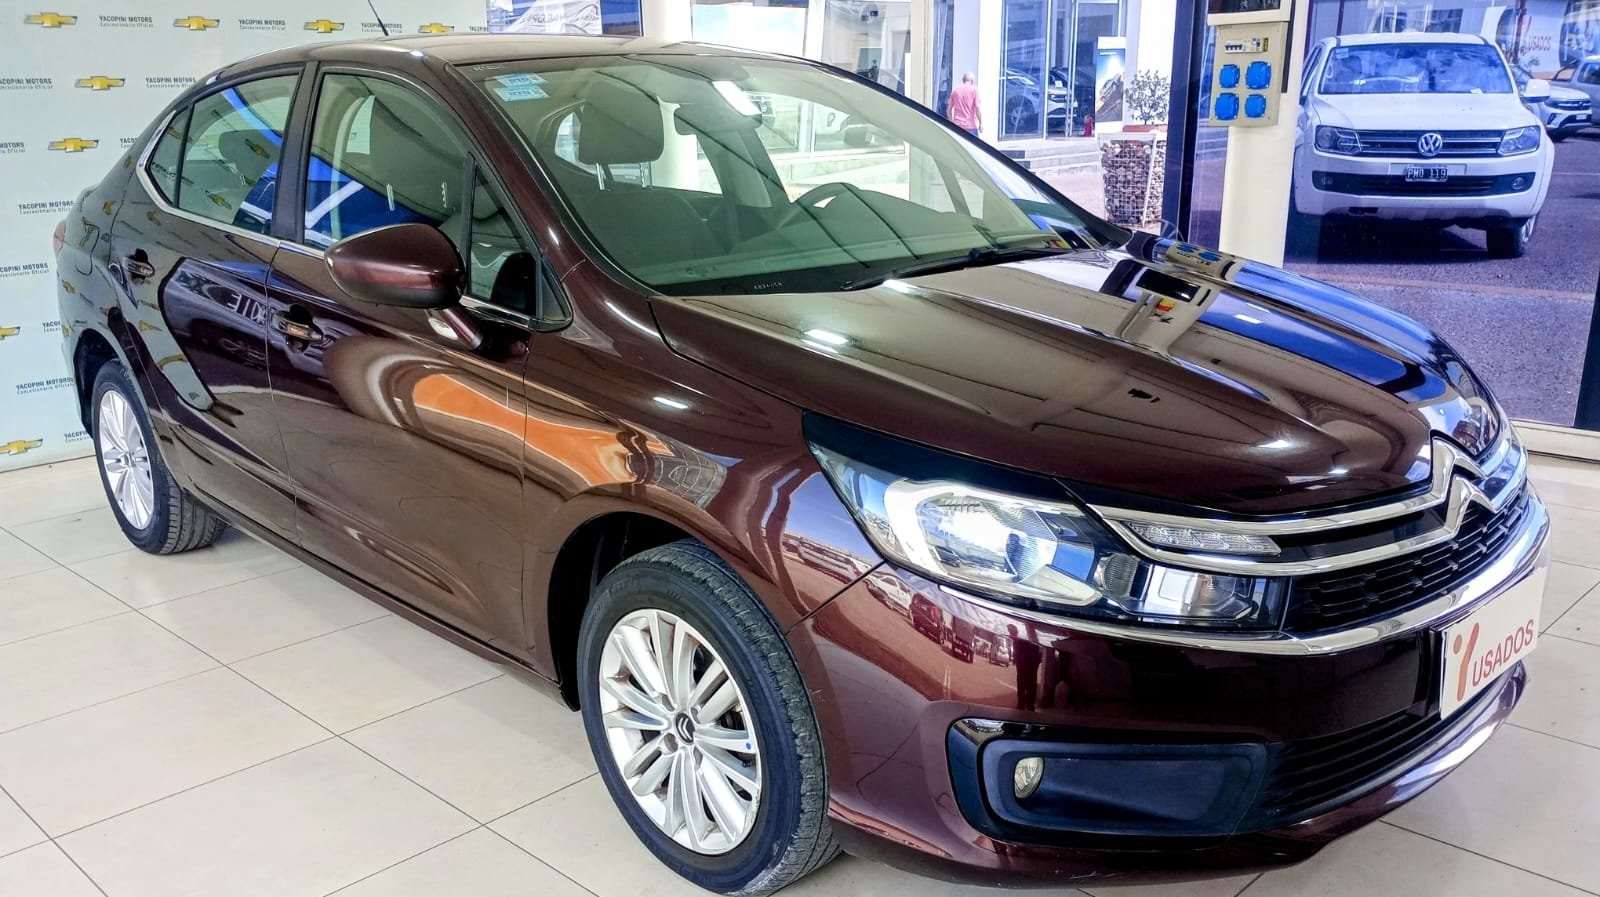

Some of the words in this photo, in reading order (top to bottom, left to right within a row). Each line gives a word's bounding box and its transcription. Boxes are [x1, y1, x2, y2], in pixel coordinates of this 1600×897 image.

[1430, 168, 1447, 179] 119
[16, 381, 44, 390] YACOPINI
[1472, 618, 1534, 687] USADOS
